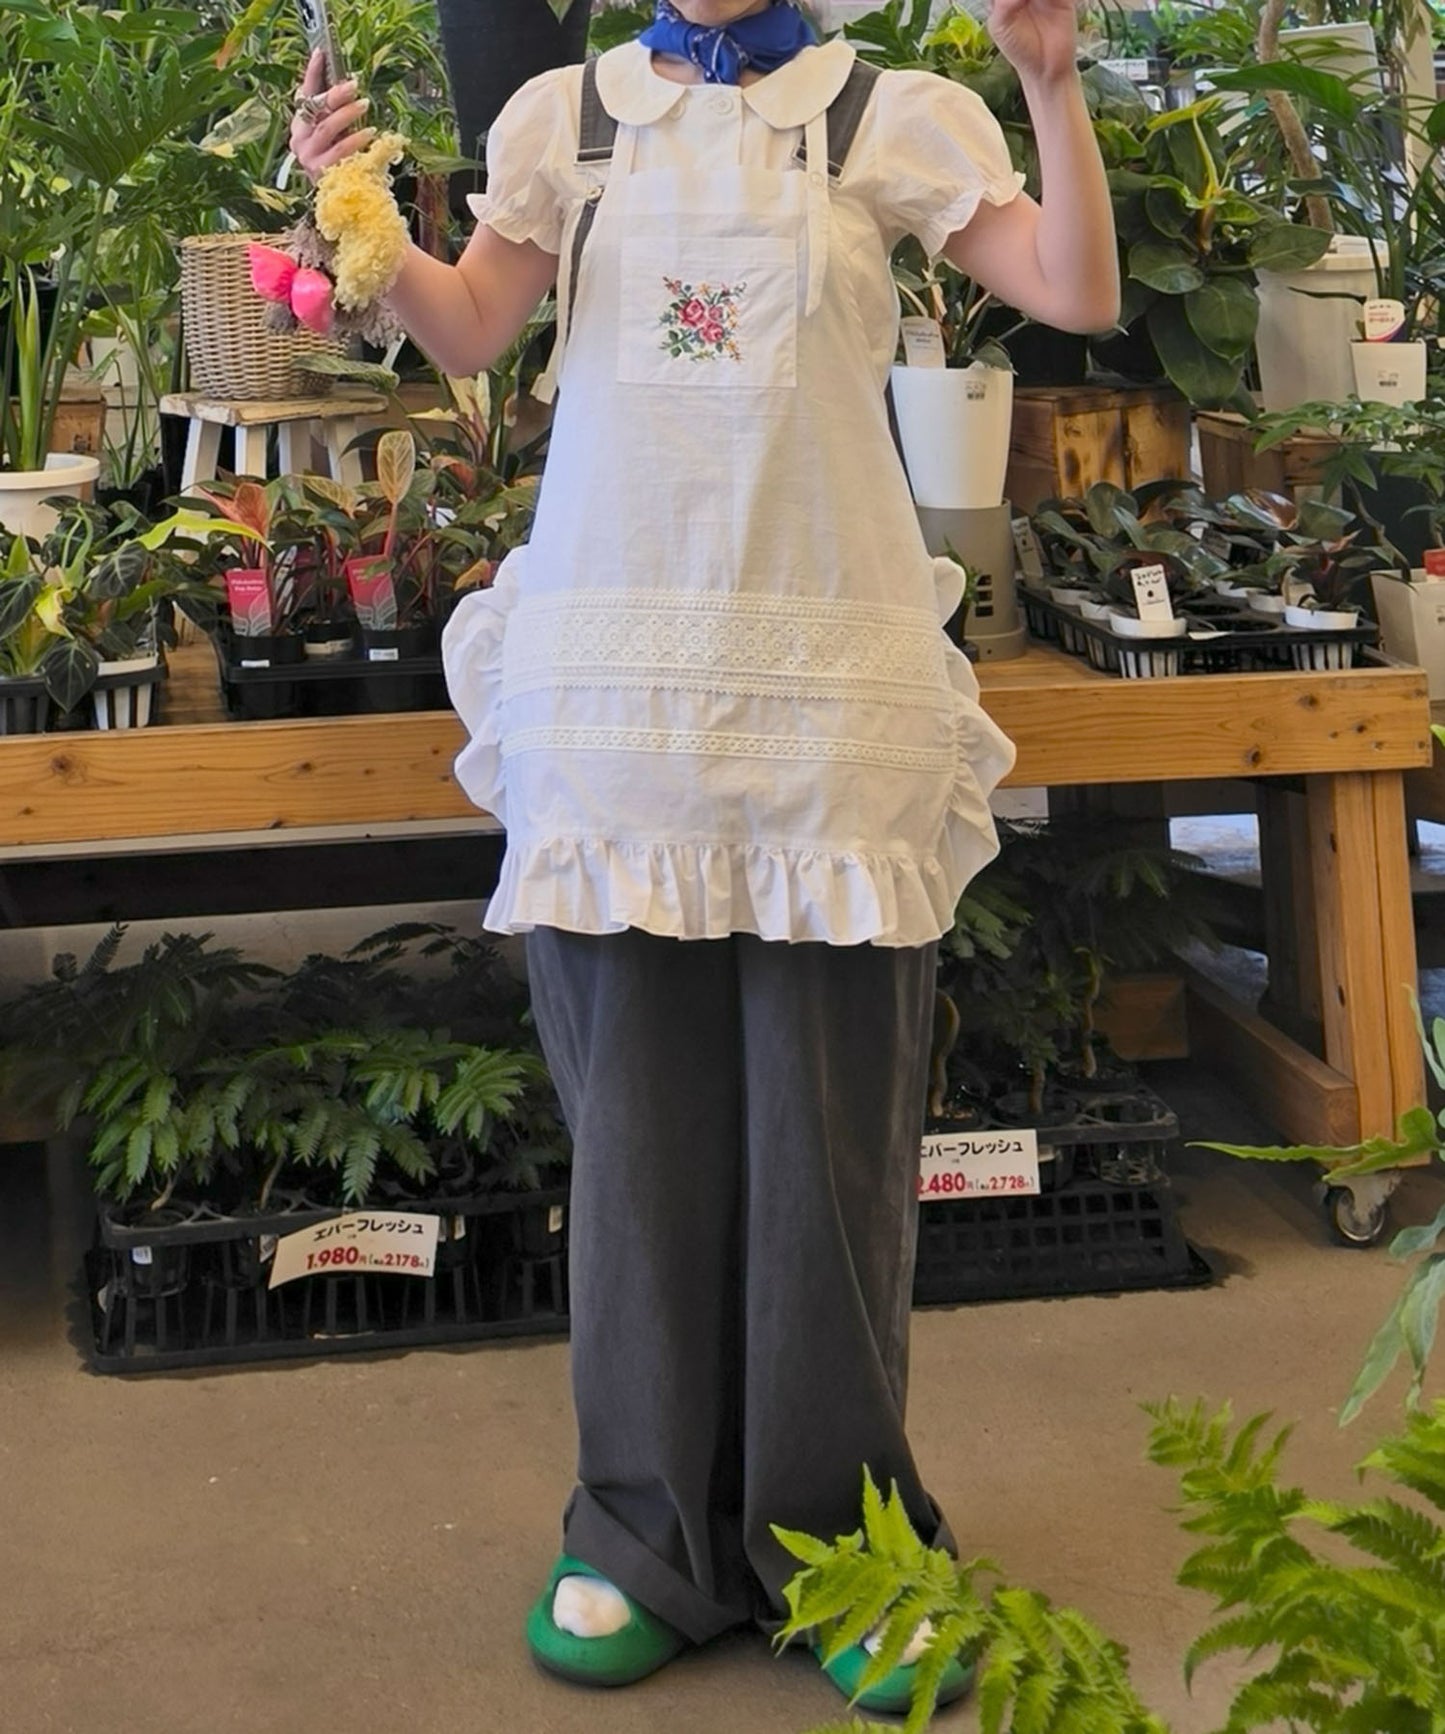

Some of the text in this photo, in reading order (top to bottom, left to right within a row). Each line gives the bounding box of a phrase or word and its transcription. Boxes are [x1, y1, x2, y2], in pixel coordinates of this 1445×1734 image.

[313, 1219, 424, 1241] エバーフレッシュ
